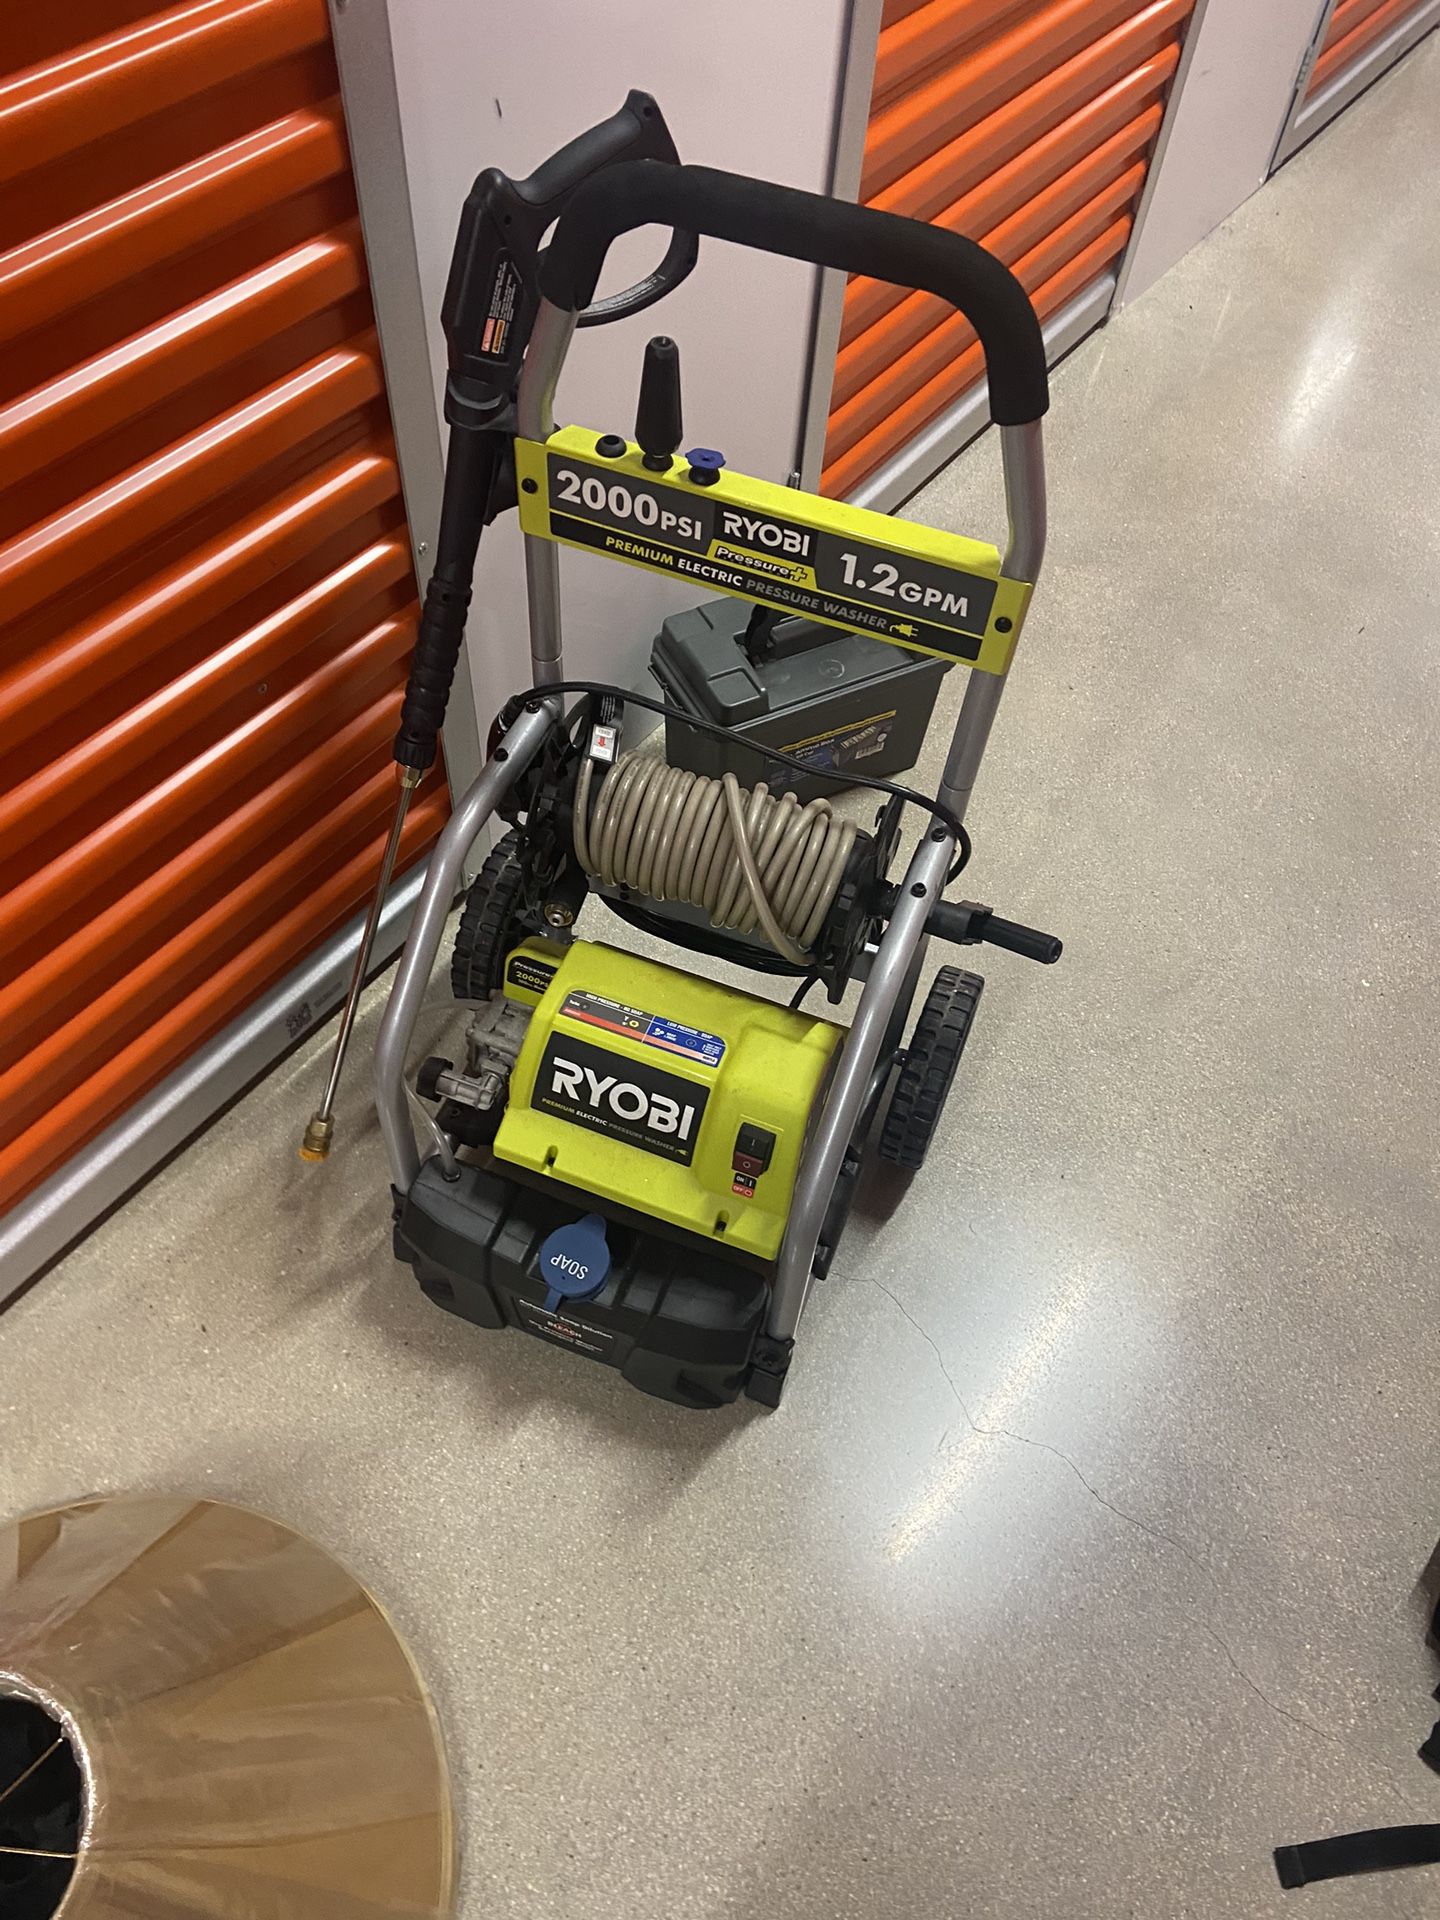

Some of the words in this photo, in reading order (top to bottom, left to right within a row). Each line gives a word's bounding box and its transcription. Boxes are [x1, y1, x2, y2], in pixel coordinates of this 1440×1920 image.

[556, 469, 702, 541] 2000PSI
[722, 511, 810, 557] RYOBI
[606, 535, 674, 566] PREMIUM
[677, 557, 744, 587] ELECTRIC
[746, 579, 818, 610] PRESSURE
[823, 600, 888, 630] WASHER
[839, 552, 968, 618] 1.2GPM
[541, 1097, 576, 1115] PREMIUM
[575, 1110, 608, 1127] ELECTRIC
[608, 1122, 644, 1141] PRESSURE
[644, 1135, 675, 1151] WASHER
[551, 1056, 695, 1141] RYOBI
[550, 1253, 589, 1280] SOAP
